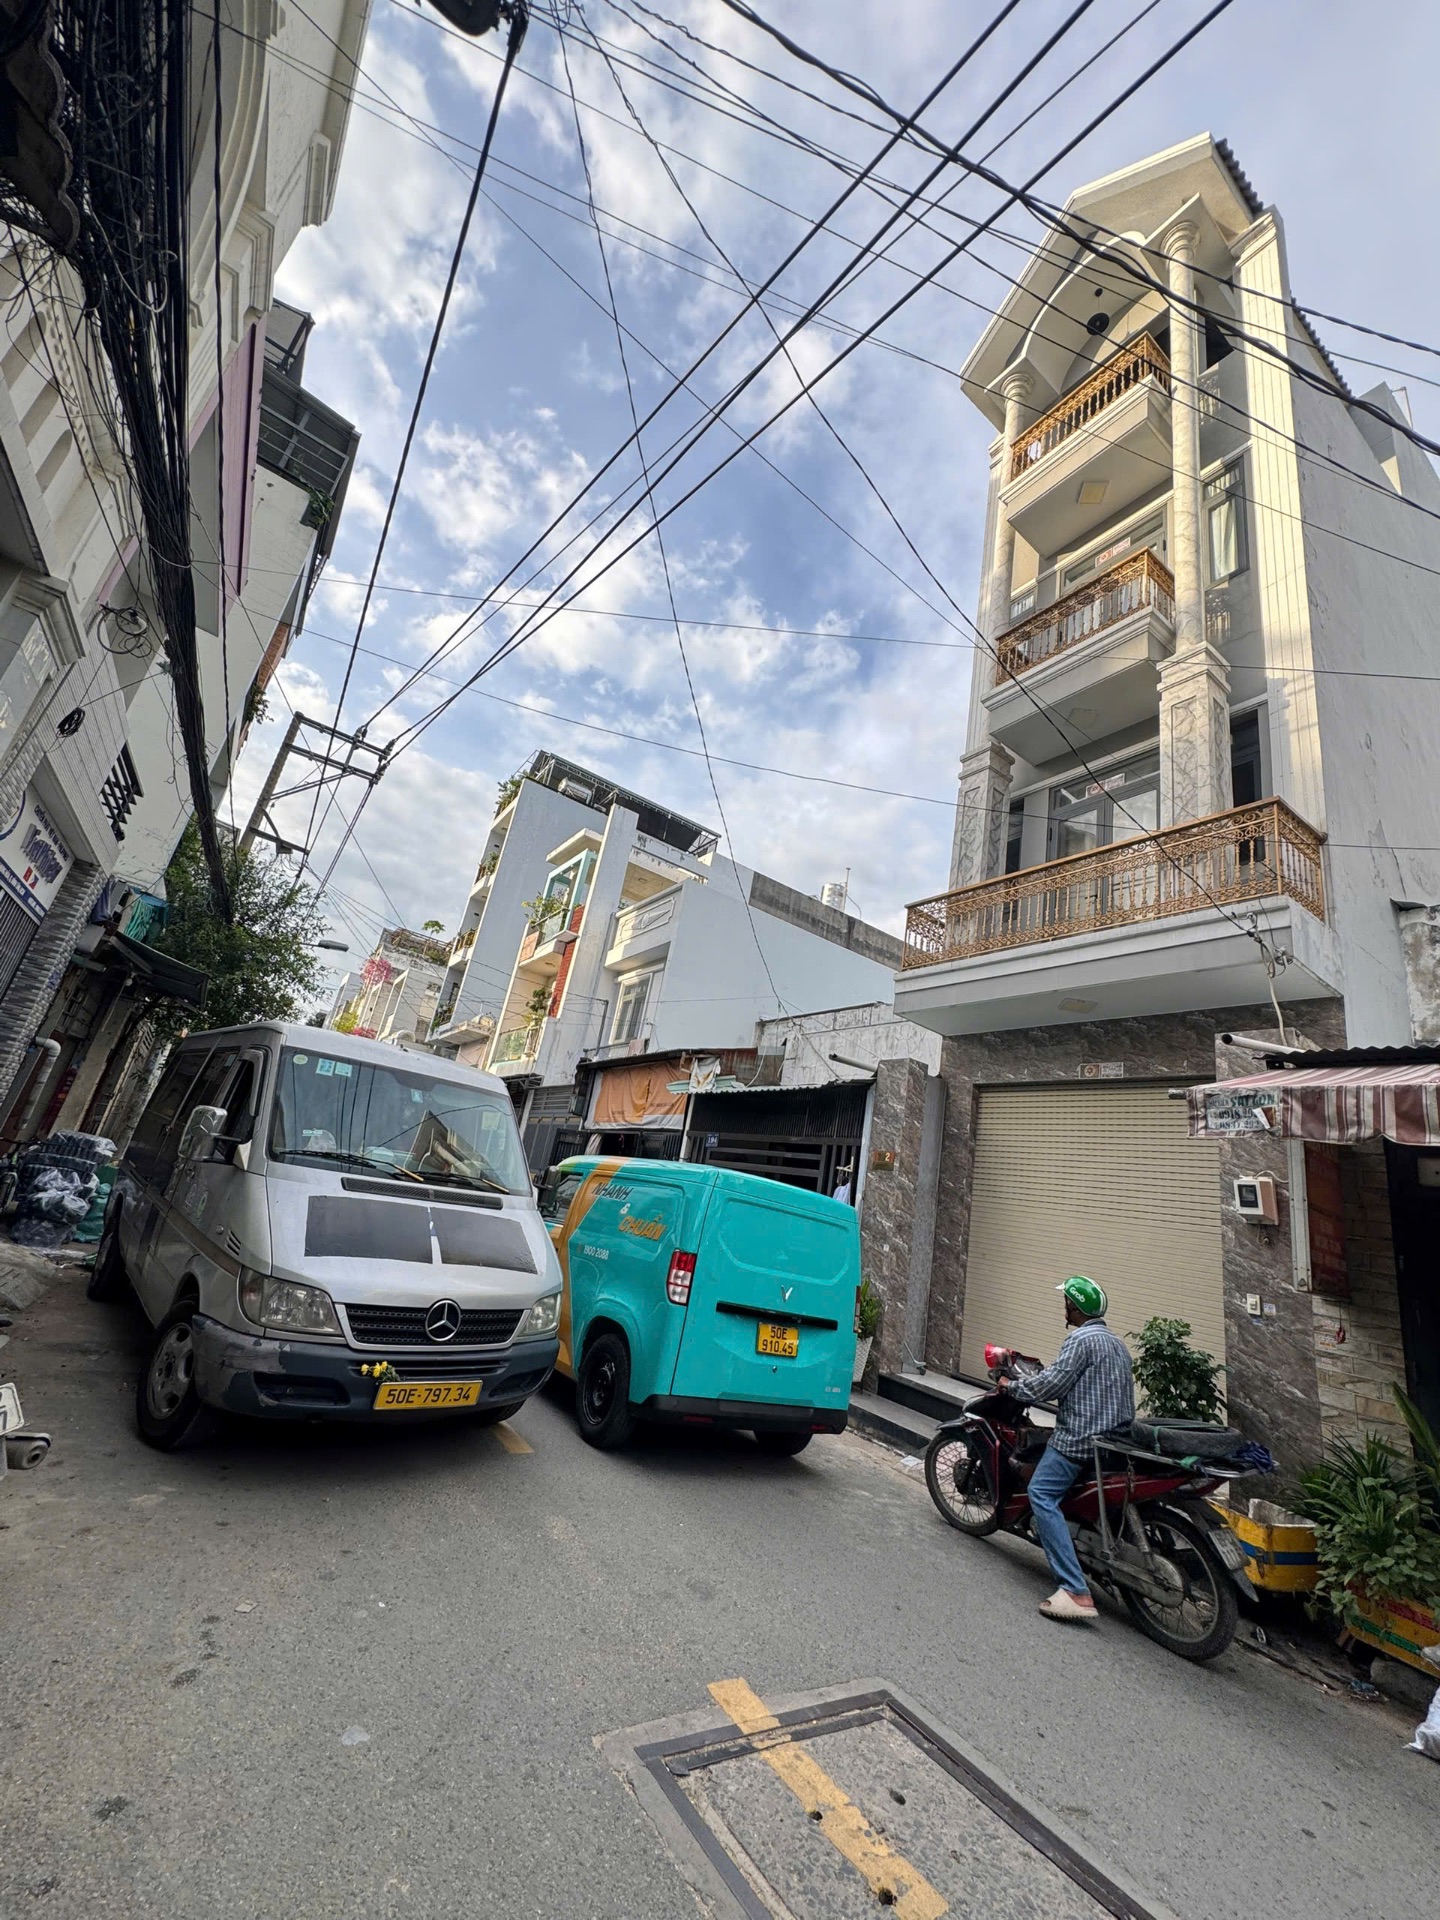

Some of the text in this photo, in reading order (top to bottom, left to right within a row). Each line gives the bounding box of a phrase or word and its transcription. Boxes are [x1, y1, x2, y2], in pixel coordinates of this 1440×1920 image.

[592, 1182, 634, 1201] NHANH
[620, 1203, 631, 1214] &
[1069, 1286, 1086, 1303] Grab
[770, 1326, 787, 1340] 50E
[762, 1339, 794, 1355] 910.45
[385, 1386, 472, 1404] 50E-797.34
